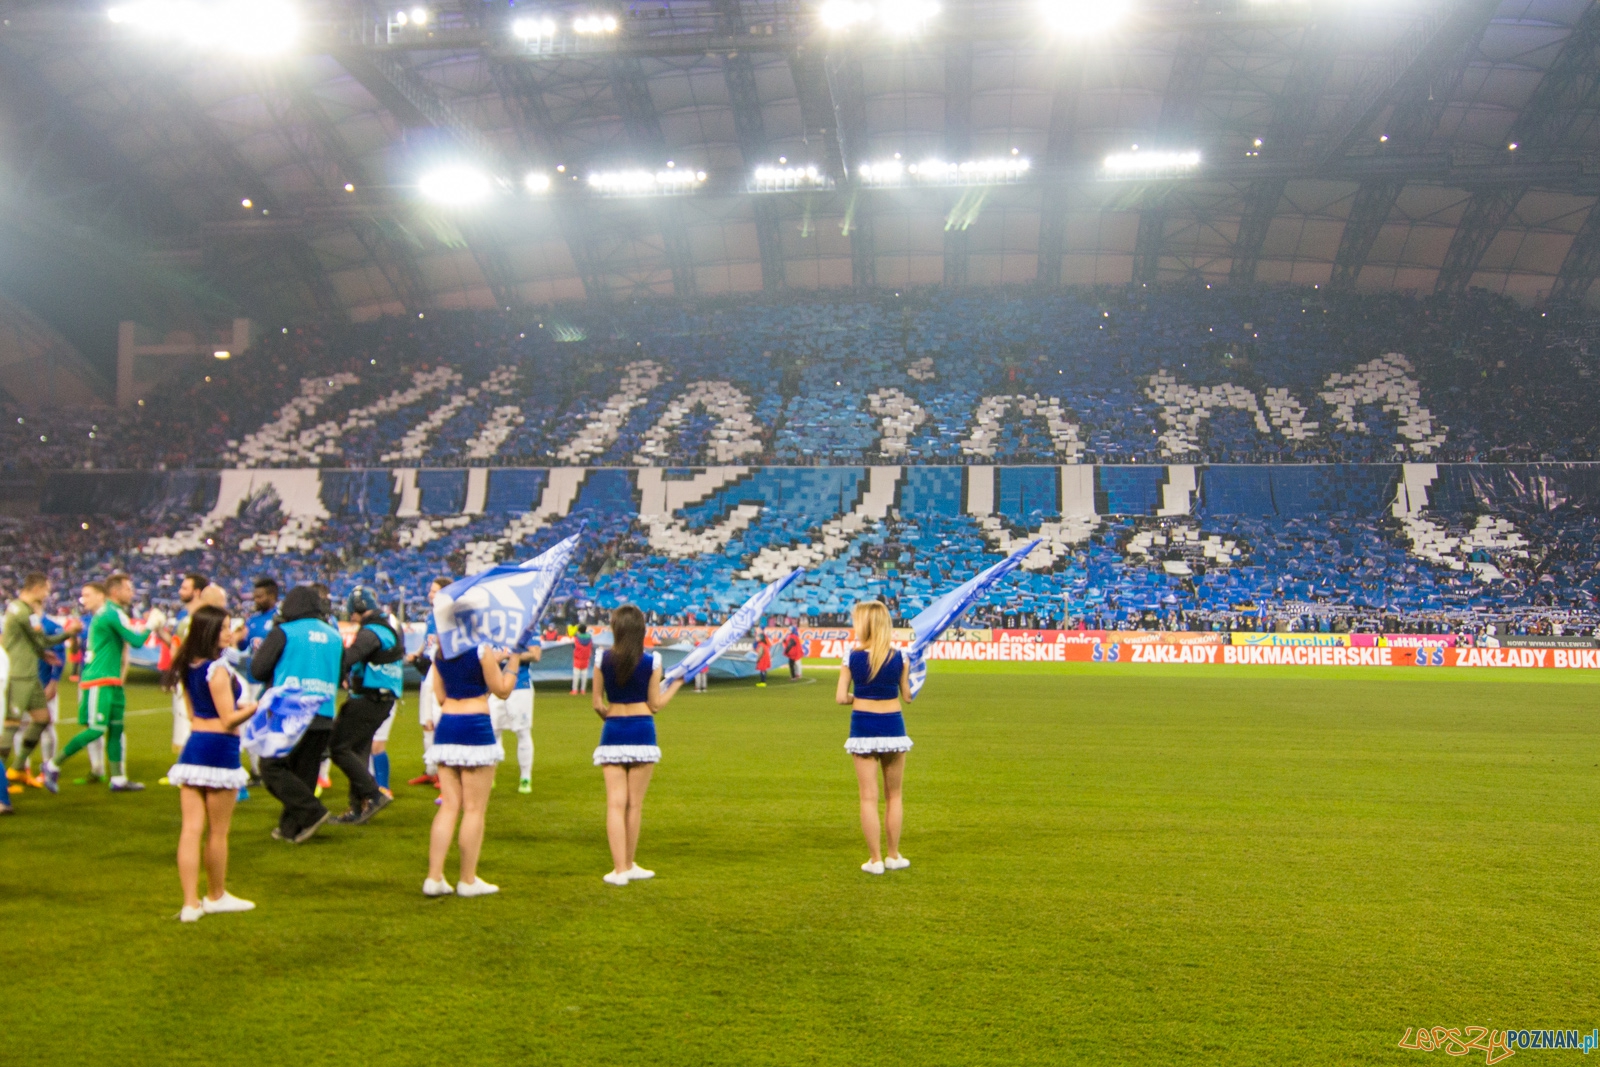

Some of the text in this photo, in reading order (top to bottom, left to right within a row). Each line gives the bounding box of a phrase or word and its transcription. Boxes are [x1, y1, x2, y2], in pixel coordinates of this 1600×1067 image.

[1000, 632, 1043, 643] Amic
[1056, 633, 1101, 644] Amica
[1374, 637, 1448, 648] ultikino
[1092, 643, 1392, 666] STS ZAKŁADY BUKMACHERSKIE
[1416, 647, 1445, 666] STS
[1456, 648, 1547, 667] ZAKŁADY
